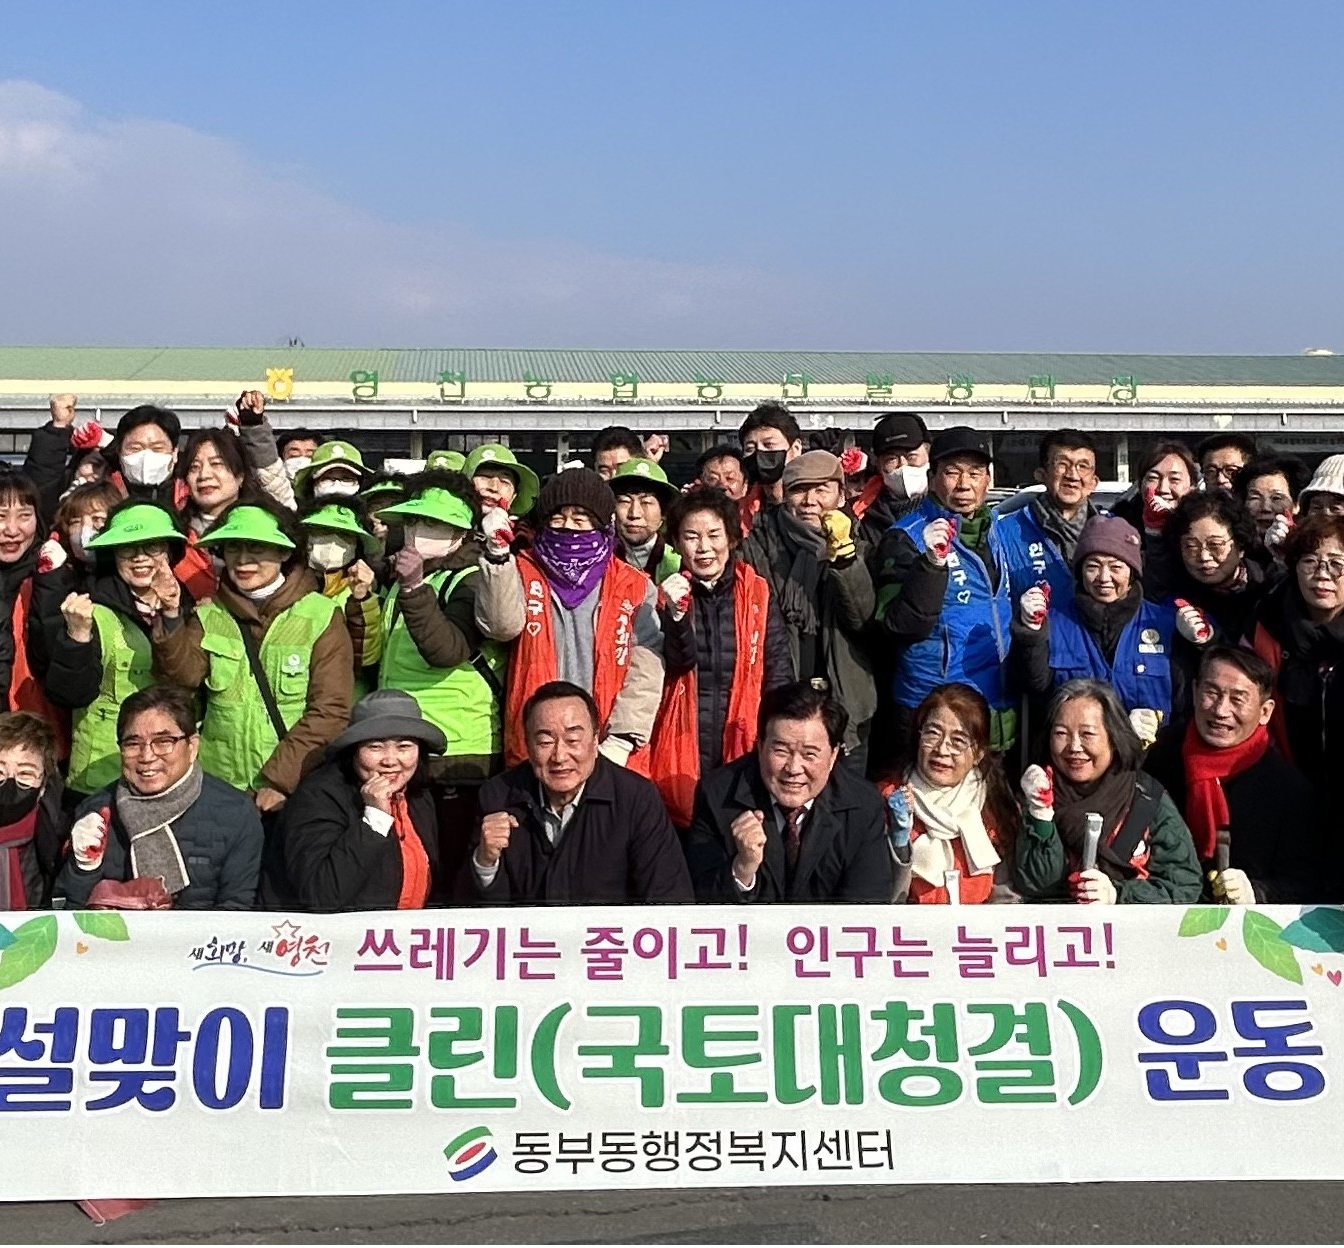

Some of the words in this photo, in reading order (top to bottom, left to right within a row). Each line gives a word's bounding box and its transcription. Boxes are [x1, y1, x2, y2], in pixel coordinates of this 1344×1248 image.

[354, 928, 561, 980] 쓰레기는
[581, 925, 748, 980] 줄이고!
[787, 927, 933, 978] 인구는
[952, 923, 1115, 978] 늘리고!
[327, 1000, 1104, 1110] 클린(국토대청결)
[1138, 1000, 1325, 1101] 운동
[513, 1129, 894, 1174] 동부동행정복지센터
